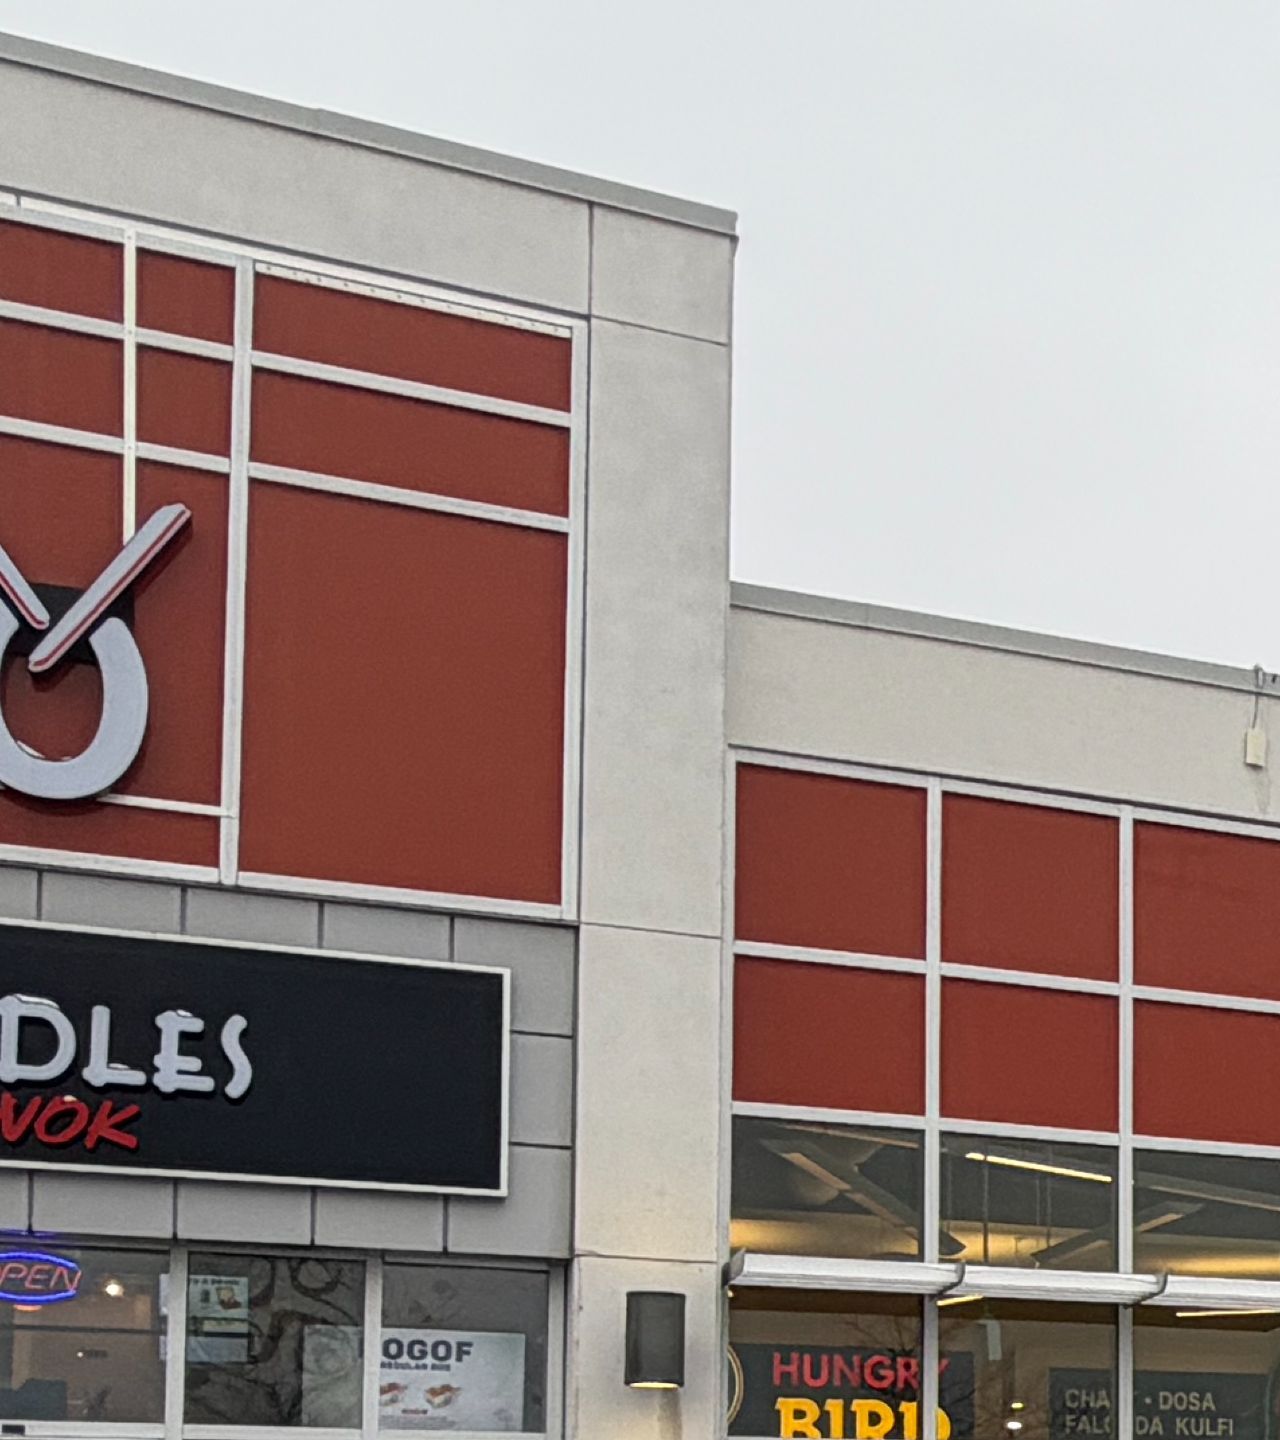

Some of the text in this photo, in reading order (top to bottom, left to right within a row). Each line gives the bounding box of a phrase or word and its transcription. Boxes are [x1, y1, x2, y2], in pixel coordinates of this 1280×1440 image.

[0, 1262, 82, 1291] PEN
[359, 1336, 473, 1362] OGOF
[772, 1351, 949, 1391] HUNGR
[1159, 1391, 1216, 1412] DOSA
[1064, 1413, 1234, 1437] FALDA KULFI
